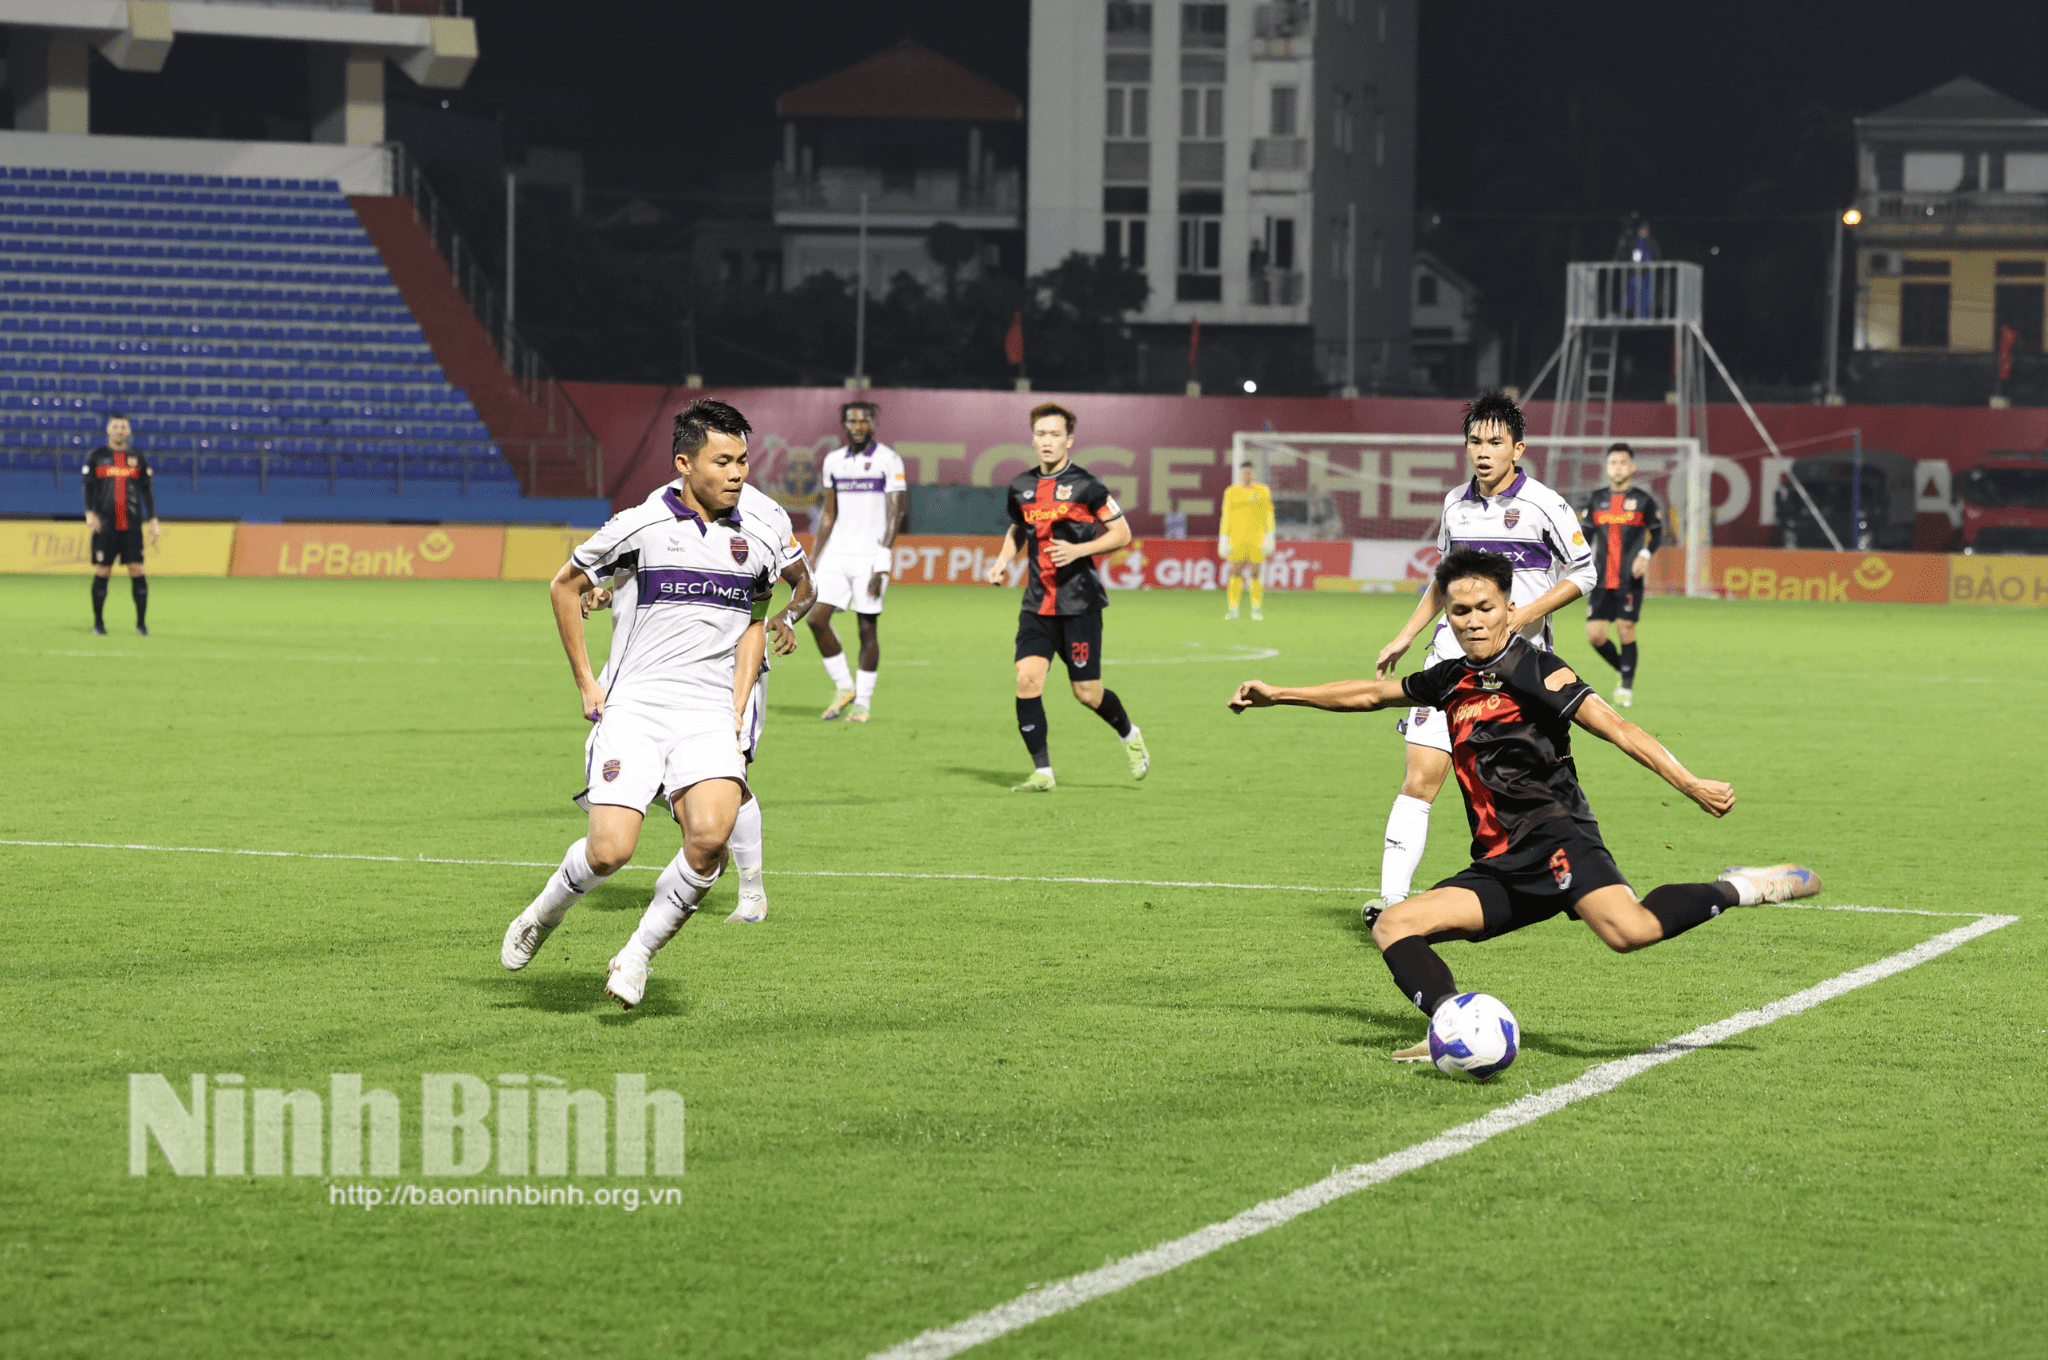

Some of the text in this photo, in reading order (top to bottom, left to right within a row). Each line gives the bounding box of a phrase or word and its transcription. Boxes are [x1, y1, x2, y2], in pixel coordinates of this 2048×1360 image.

[278, 543, 415, 575] LPBank
[893, 547, 944, 580] PT
[1722, 567, 1850, 601] PBank
[1952, 563, 2026, 602] BẢO
